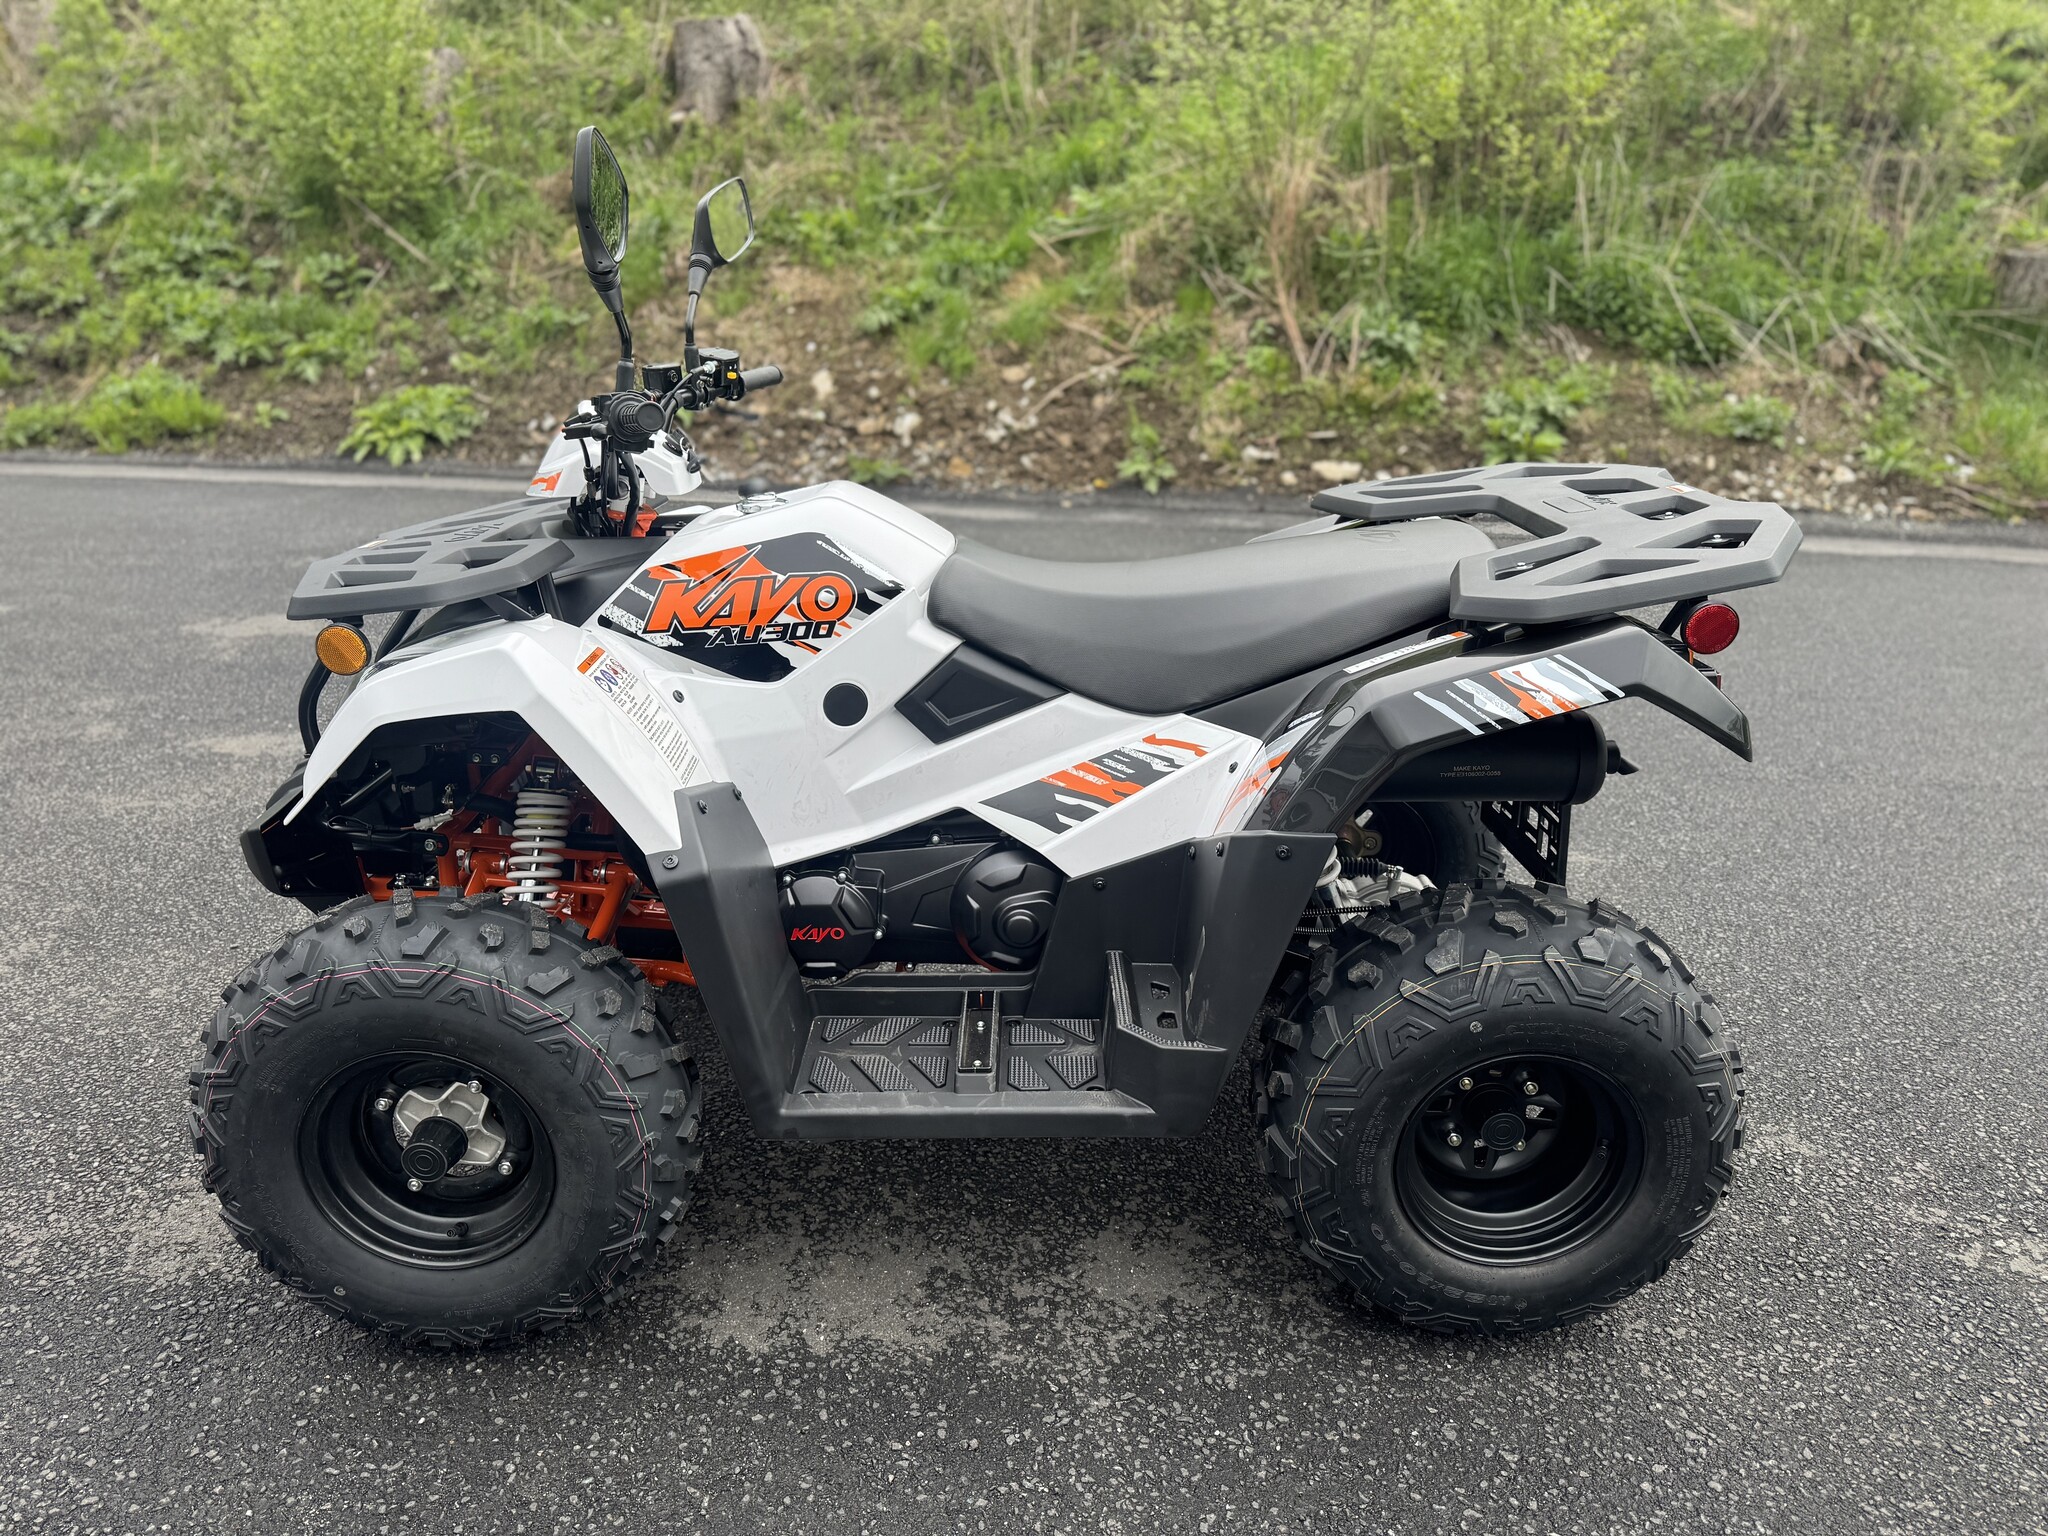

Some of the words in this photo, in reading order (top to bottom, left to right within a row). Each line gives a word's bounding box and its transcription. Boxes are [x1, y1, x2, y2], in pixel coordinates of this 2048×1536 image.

[641, 545, 857, 634] KAYO
[705, 619, 838, 648] AU300
[790, 924, 845, 943] KAYO
